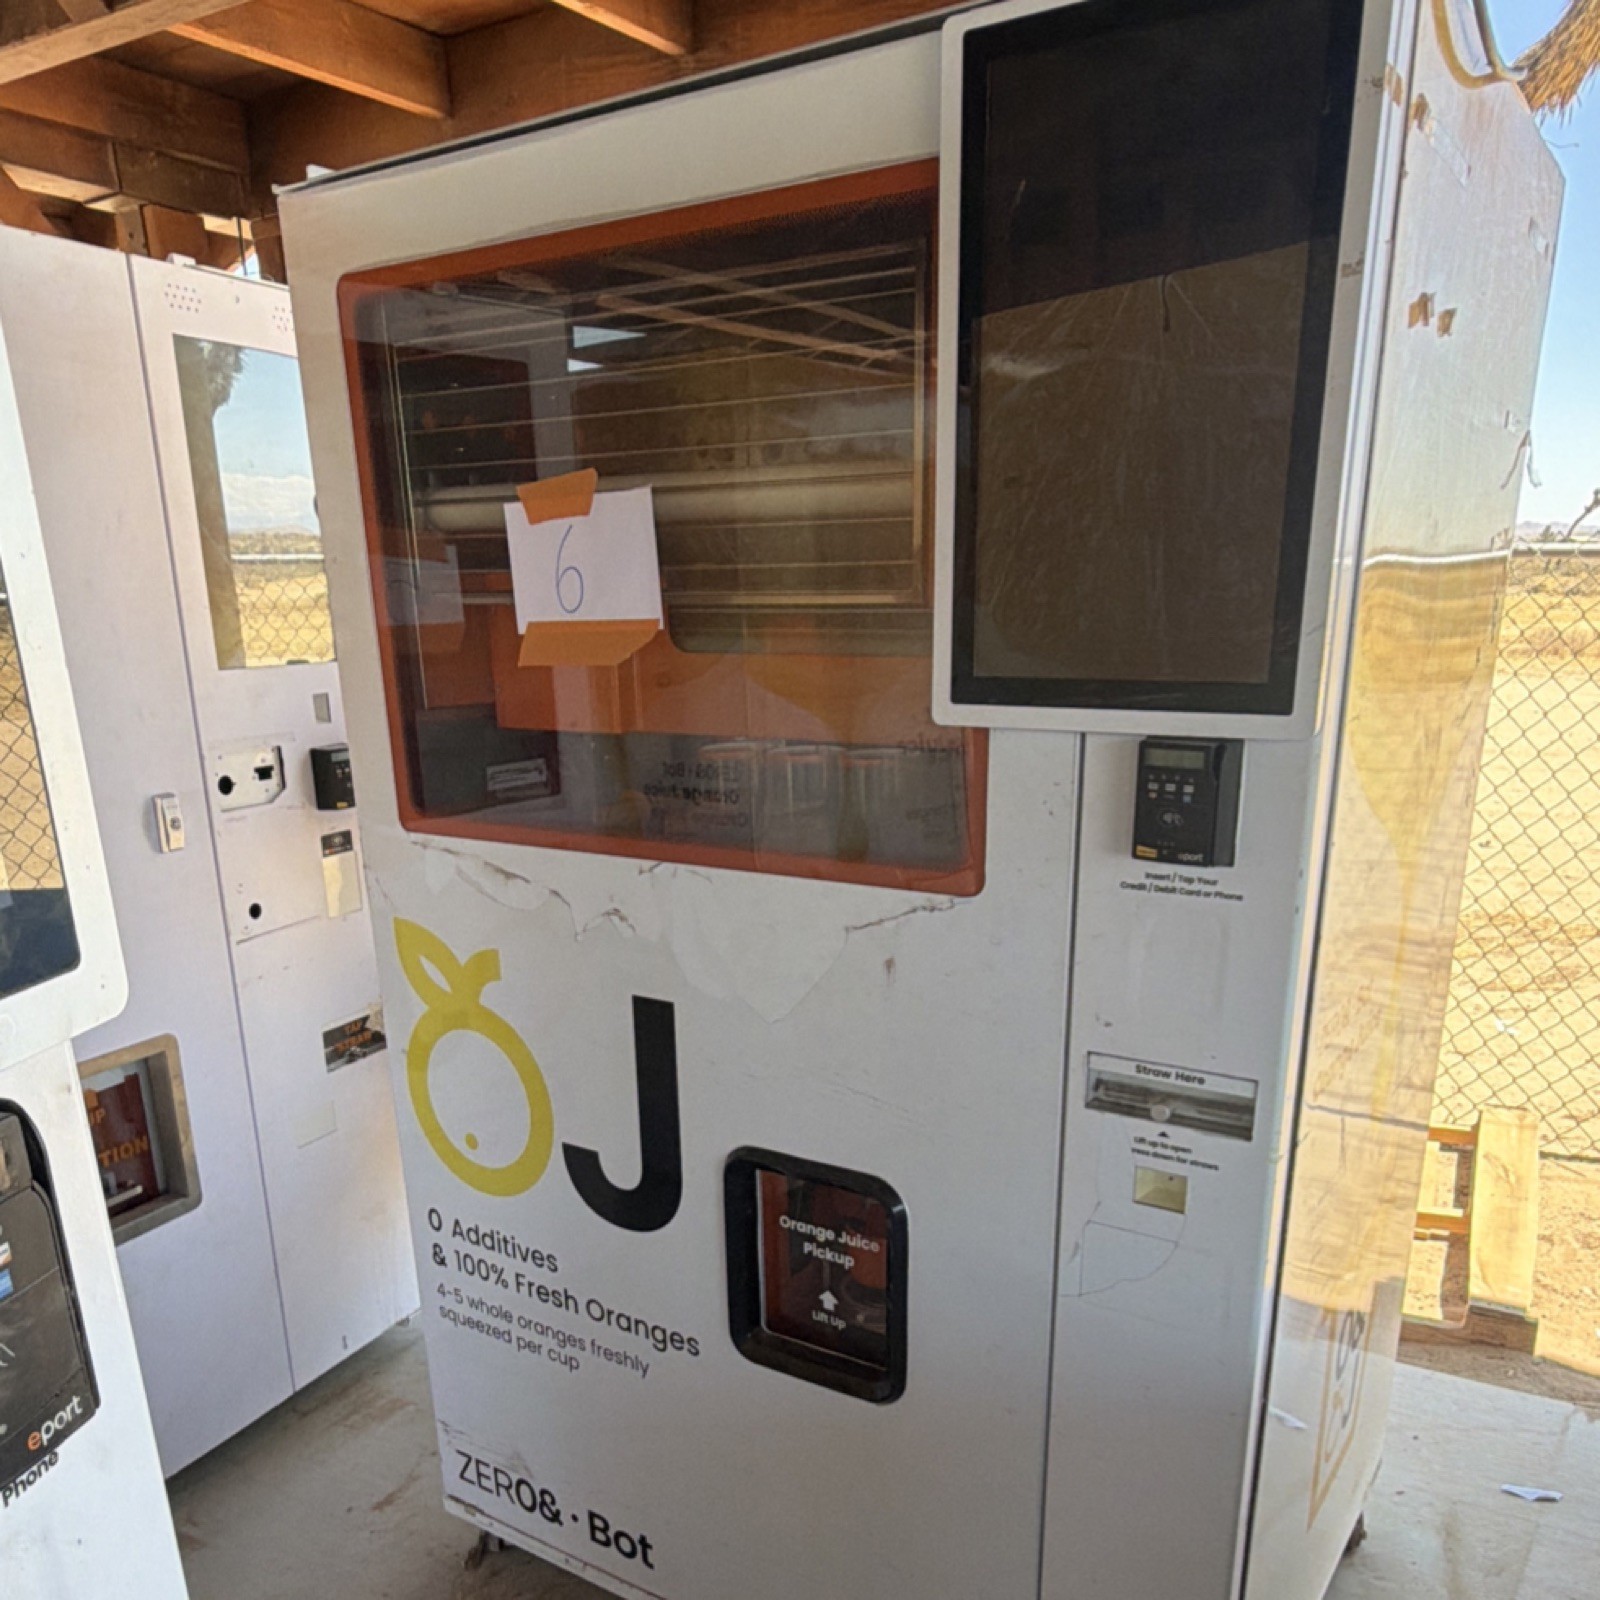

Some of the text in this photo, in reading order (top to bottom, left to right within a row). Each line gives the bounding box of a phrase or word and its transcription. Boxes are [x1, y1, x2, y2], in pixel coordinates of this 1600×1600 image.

[555, 524, 584, 614] 6
[1179, 888, 1202, 896] Card
[1213, 891, 1244, 901] Phone
[1135, 1064, 1206, 1085] Straw Here
[99, 1135, 149, 1168] TION
[451, 1218, 559, 1273] Additives
[779, 1214, 880, 1252] Orange Juice
[803, 1242, 855, 1270] Pickup
[432, 1242, 700, 1357] & 100% Fresh Oranges
[436, 1282, 650, 1379] 4-5 whole oranges freshly
[438, 1305, 580, 1373] squeezed per cup
[27, 1396, 83, 1451] eport
[1, 1451, 59, 1508] Phone
[588, 1509, 655, 1571] Bot
